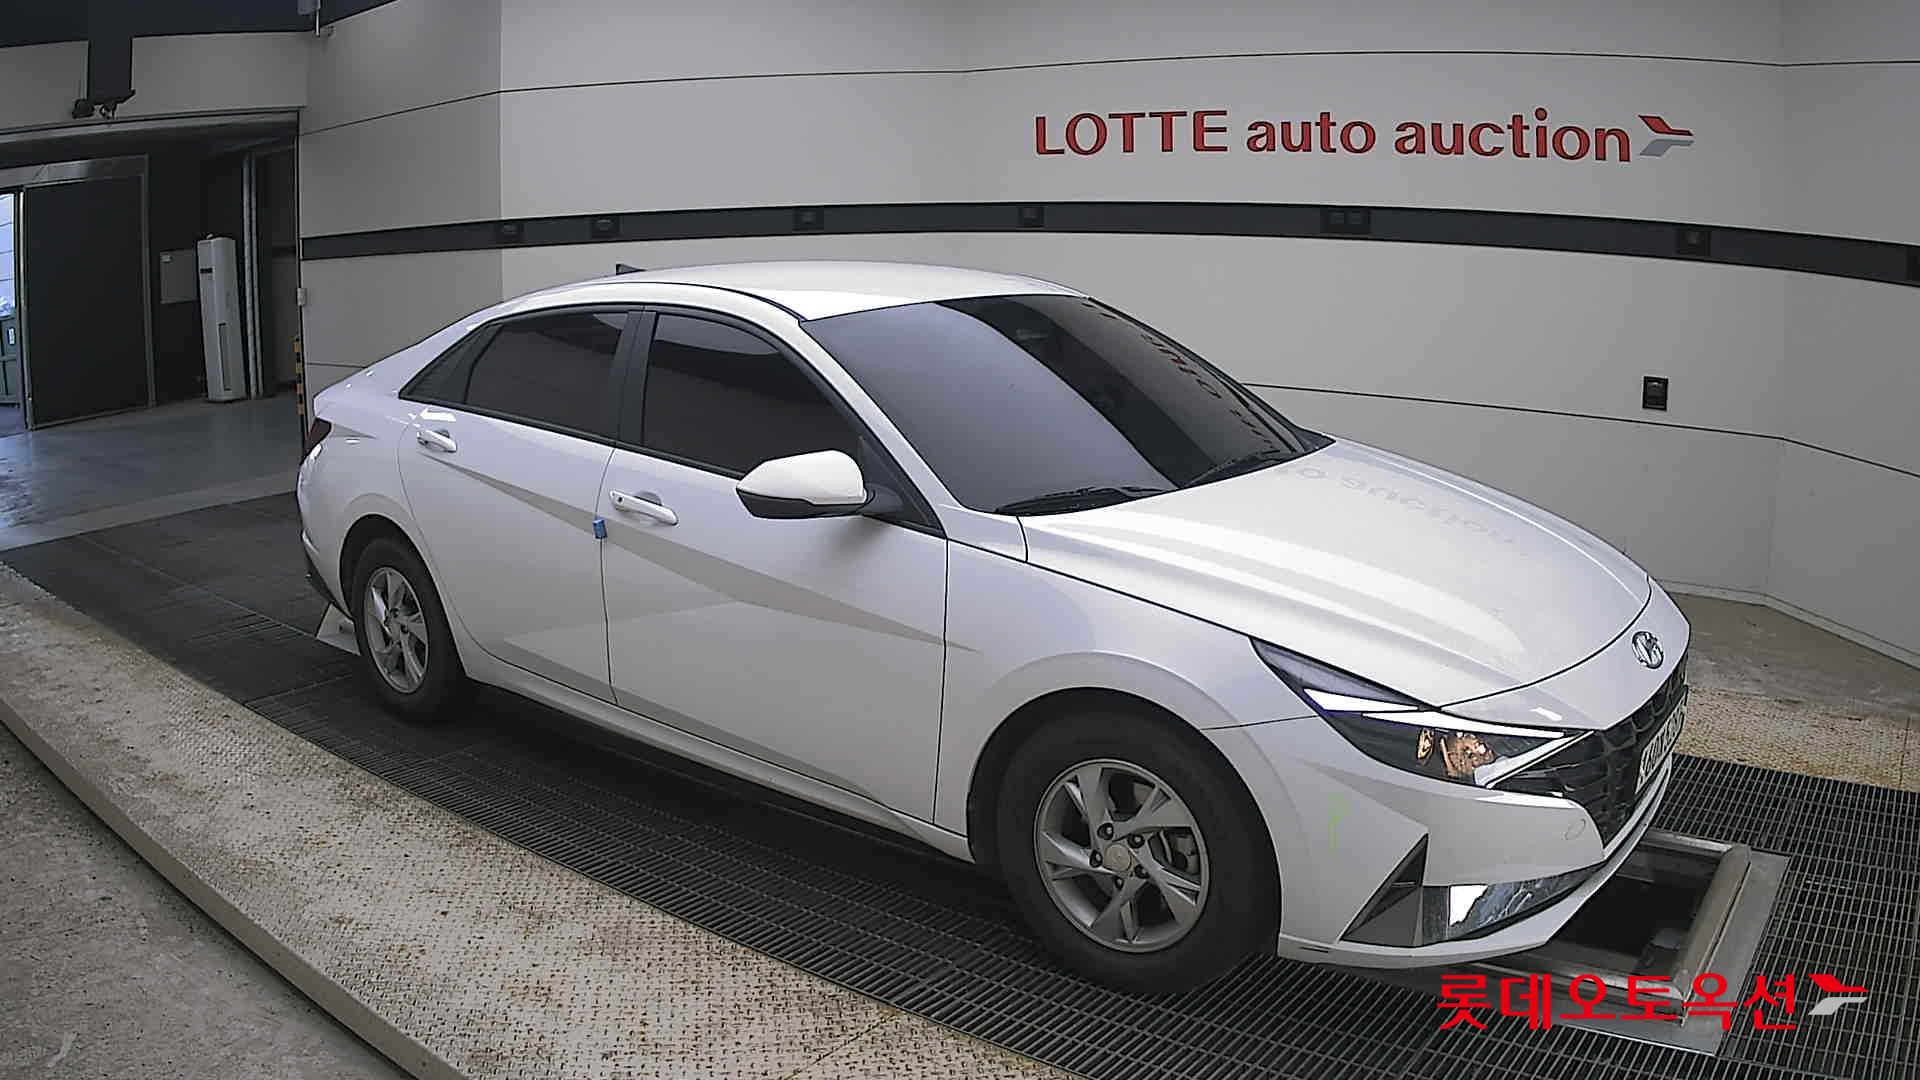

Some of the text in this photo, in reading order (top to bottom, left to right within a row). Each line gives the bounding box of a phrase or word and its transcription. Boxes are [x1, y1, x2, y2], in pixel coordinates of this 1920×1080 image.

[1035, 107, 1632, 163] LOTTE auto auction
